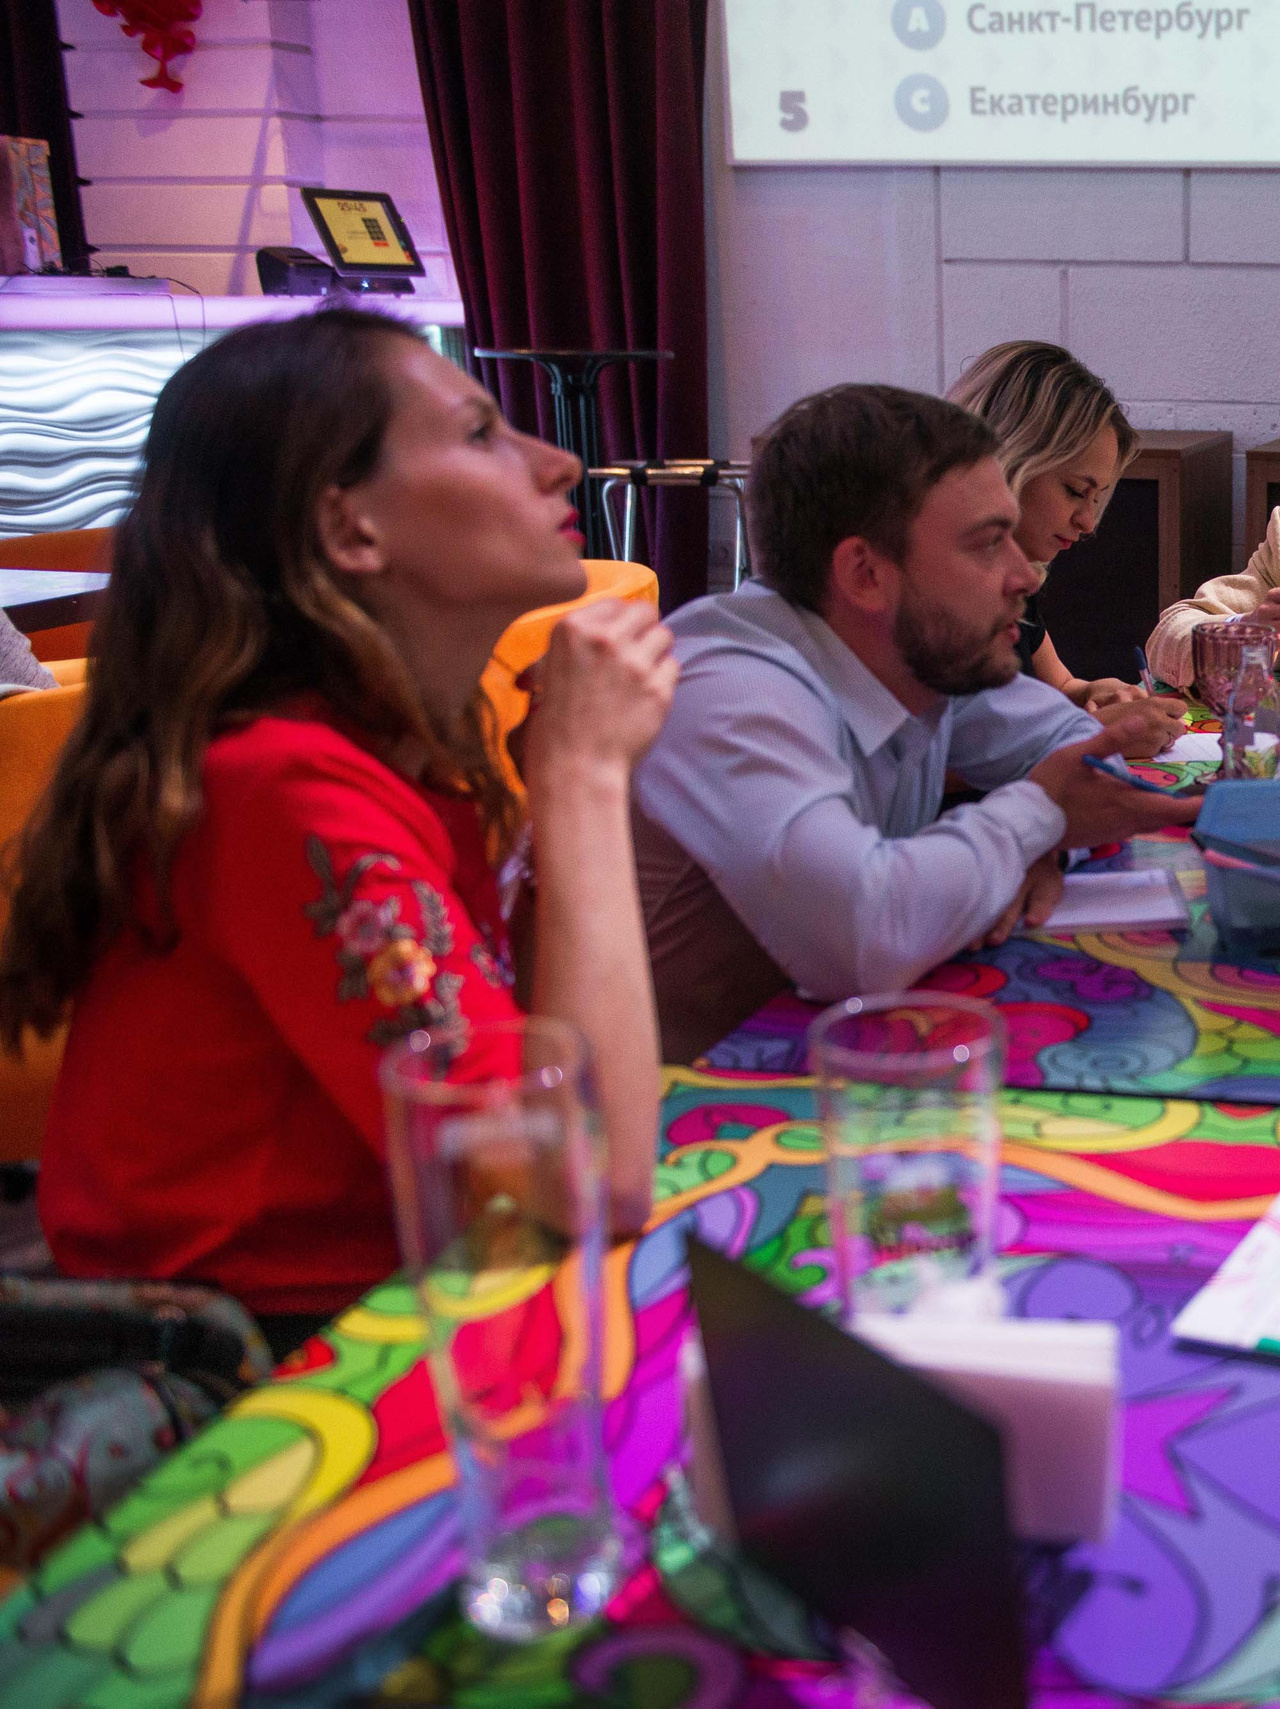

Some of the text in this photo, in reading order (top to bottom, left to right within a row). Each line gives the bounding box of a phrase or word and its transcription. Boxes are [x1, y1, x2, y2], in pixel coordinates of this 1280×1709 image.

[907, 1, 1250, 40] A Санкт-Петербург
[779, 90, 809, 132] 5
[910, 84, 1196, 124] C Екатеринбург
